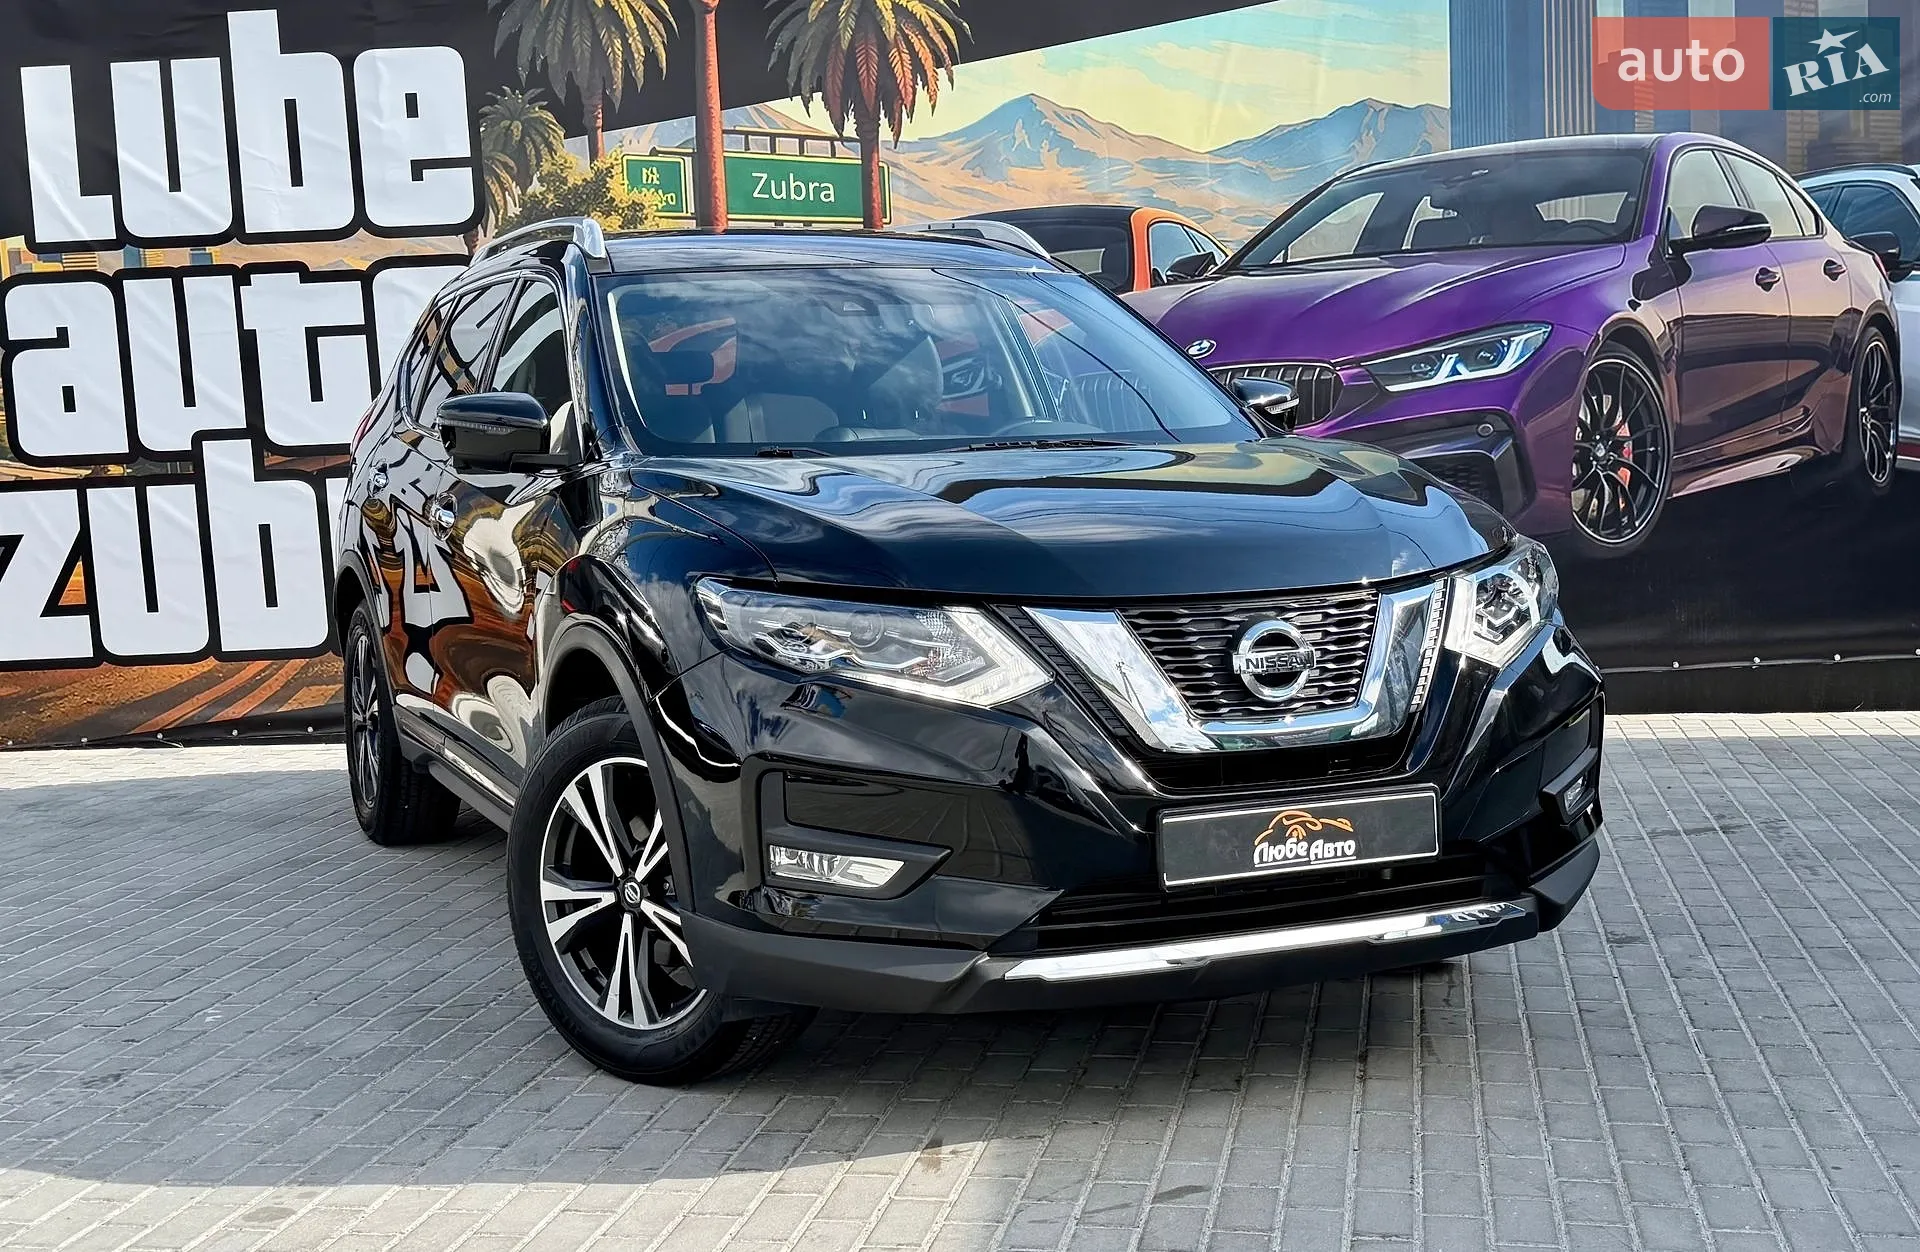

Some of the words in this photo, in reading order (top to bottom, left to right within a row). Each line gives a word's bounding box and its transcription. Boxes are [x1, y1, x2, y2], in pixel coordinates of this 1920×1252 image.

[751, 171, 836, 203] Zubra
[0, 438, 350, 661] zub
[1244, 649, 1314, 671] NISSAN
[1253, 837, 1309, 865] Любе
[1309, 838, 1356, 861] Авто
